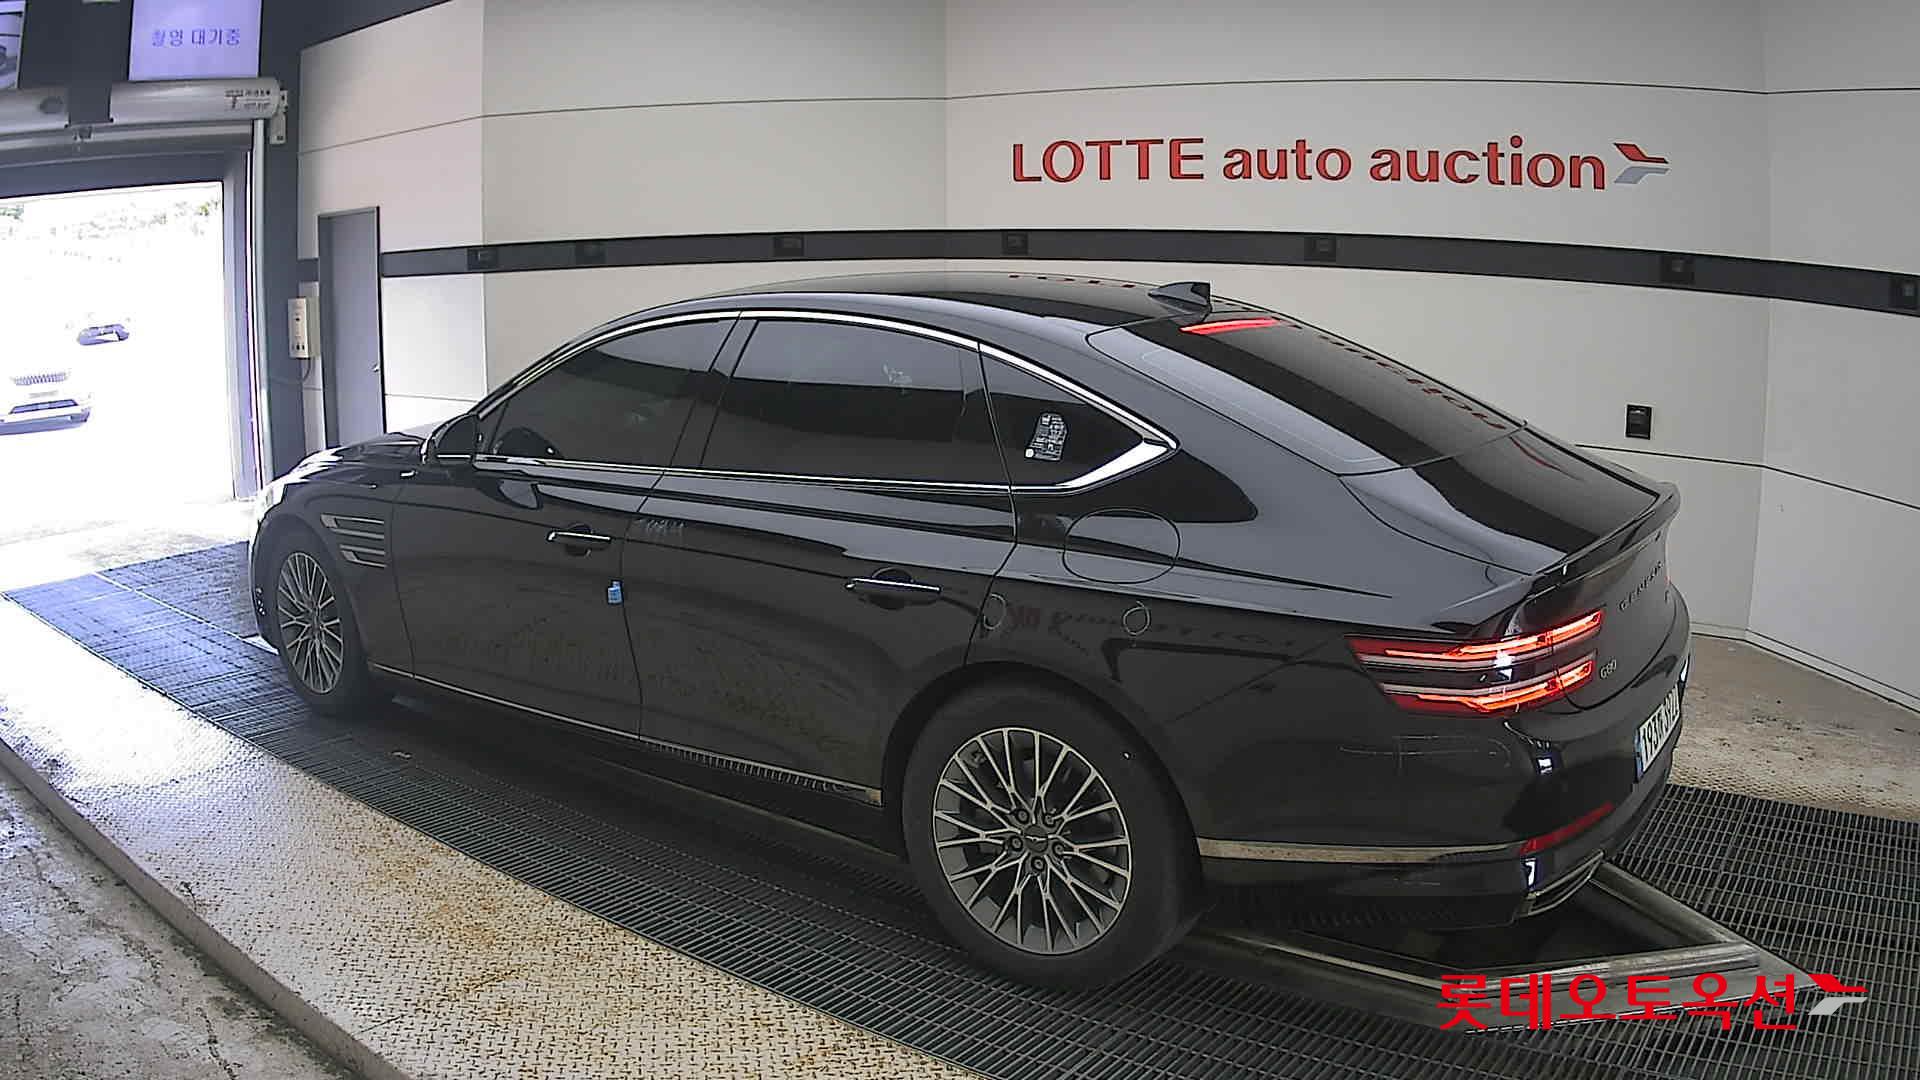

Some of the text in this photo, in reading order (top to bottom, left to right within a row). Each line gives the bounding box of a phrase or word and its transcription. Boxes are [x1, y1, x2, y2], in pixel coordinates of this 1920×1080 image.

[191, 28, 240, 46] 대기중
[1013, 135, 1606, 190] LOTTE auto auction
[1600, 658, 1617, 680] G80
